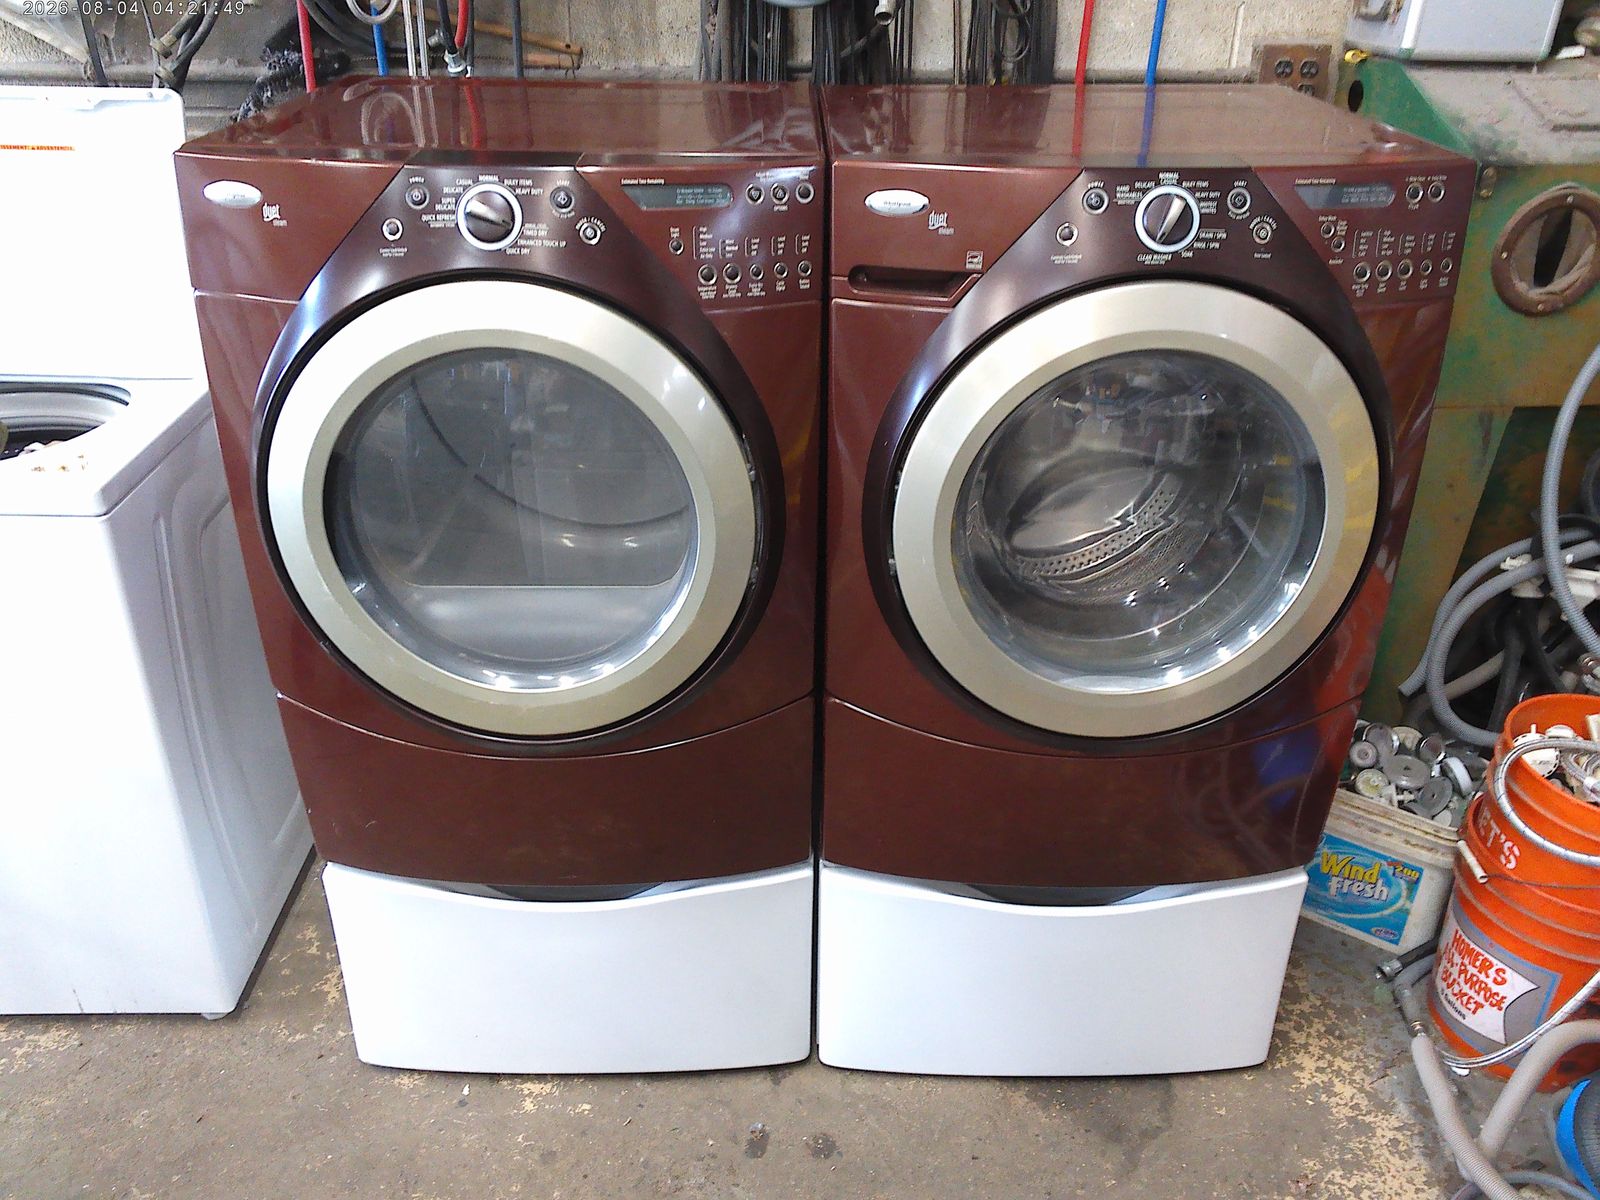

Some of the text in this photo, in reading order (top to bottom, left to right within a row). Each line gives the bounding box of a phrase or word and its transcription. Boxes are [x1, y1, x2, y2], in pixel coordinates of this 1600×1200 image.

[443, 186, 463, 194] DELICATE
[456, 178, 474, 186] CASUAL
[421, 214, 436, 222] QUICK
[928, 209, 948, 230] duet
[1321, 849, 1381, 885] Wind
[1329, 876, 1389, 901] Fresh
[1452, 928, 1507, 986] HOMER'S
[1441, 965, 1484, 1015] BUCKET
